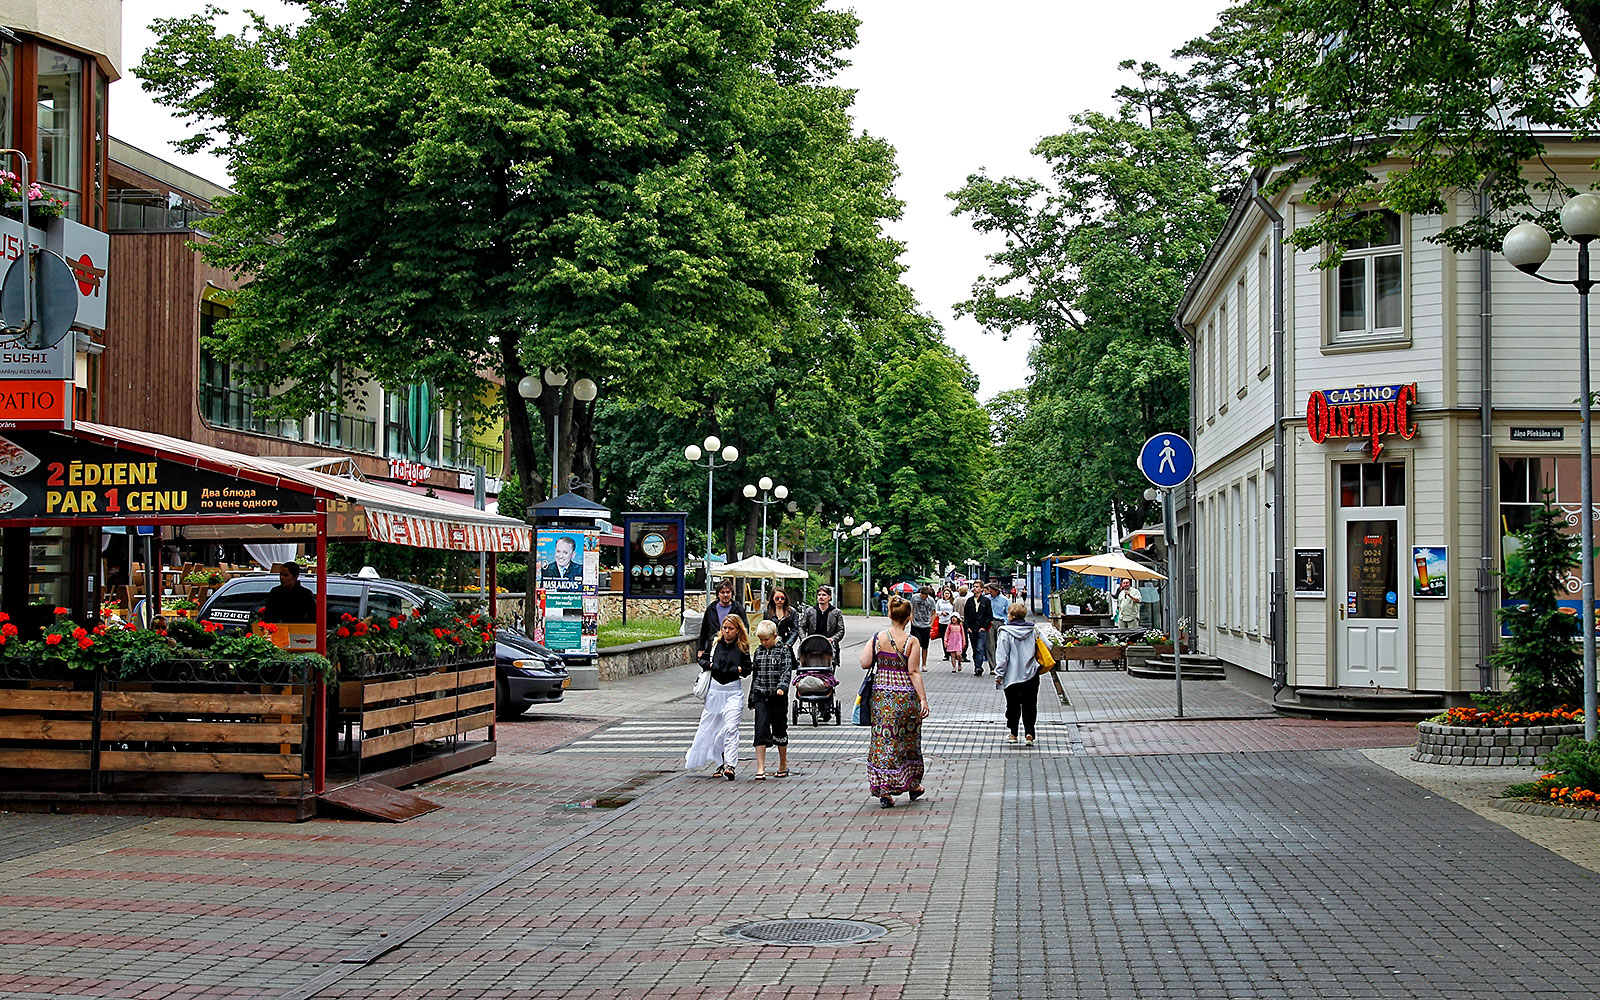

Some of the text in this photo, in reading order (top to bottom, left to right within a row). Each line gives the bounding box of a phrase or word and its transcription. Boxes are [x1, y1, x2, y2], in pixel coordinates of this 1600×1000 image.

[3, 353, 48, 364] SUSHI
[0, 368, 19, 376] APĀŅU
[1330, 386, 1392, 403] CASINO
[1306, 382, 1419, 463] OLYMPIC
[47, 460, 158, 486] 2 ĒDIENI
[201, 487, 256, 499] Два блюда
[46, 488, 188, 513] PAR 1 CENU
[201, 499, 278, 509] по цене одного
